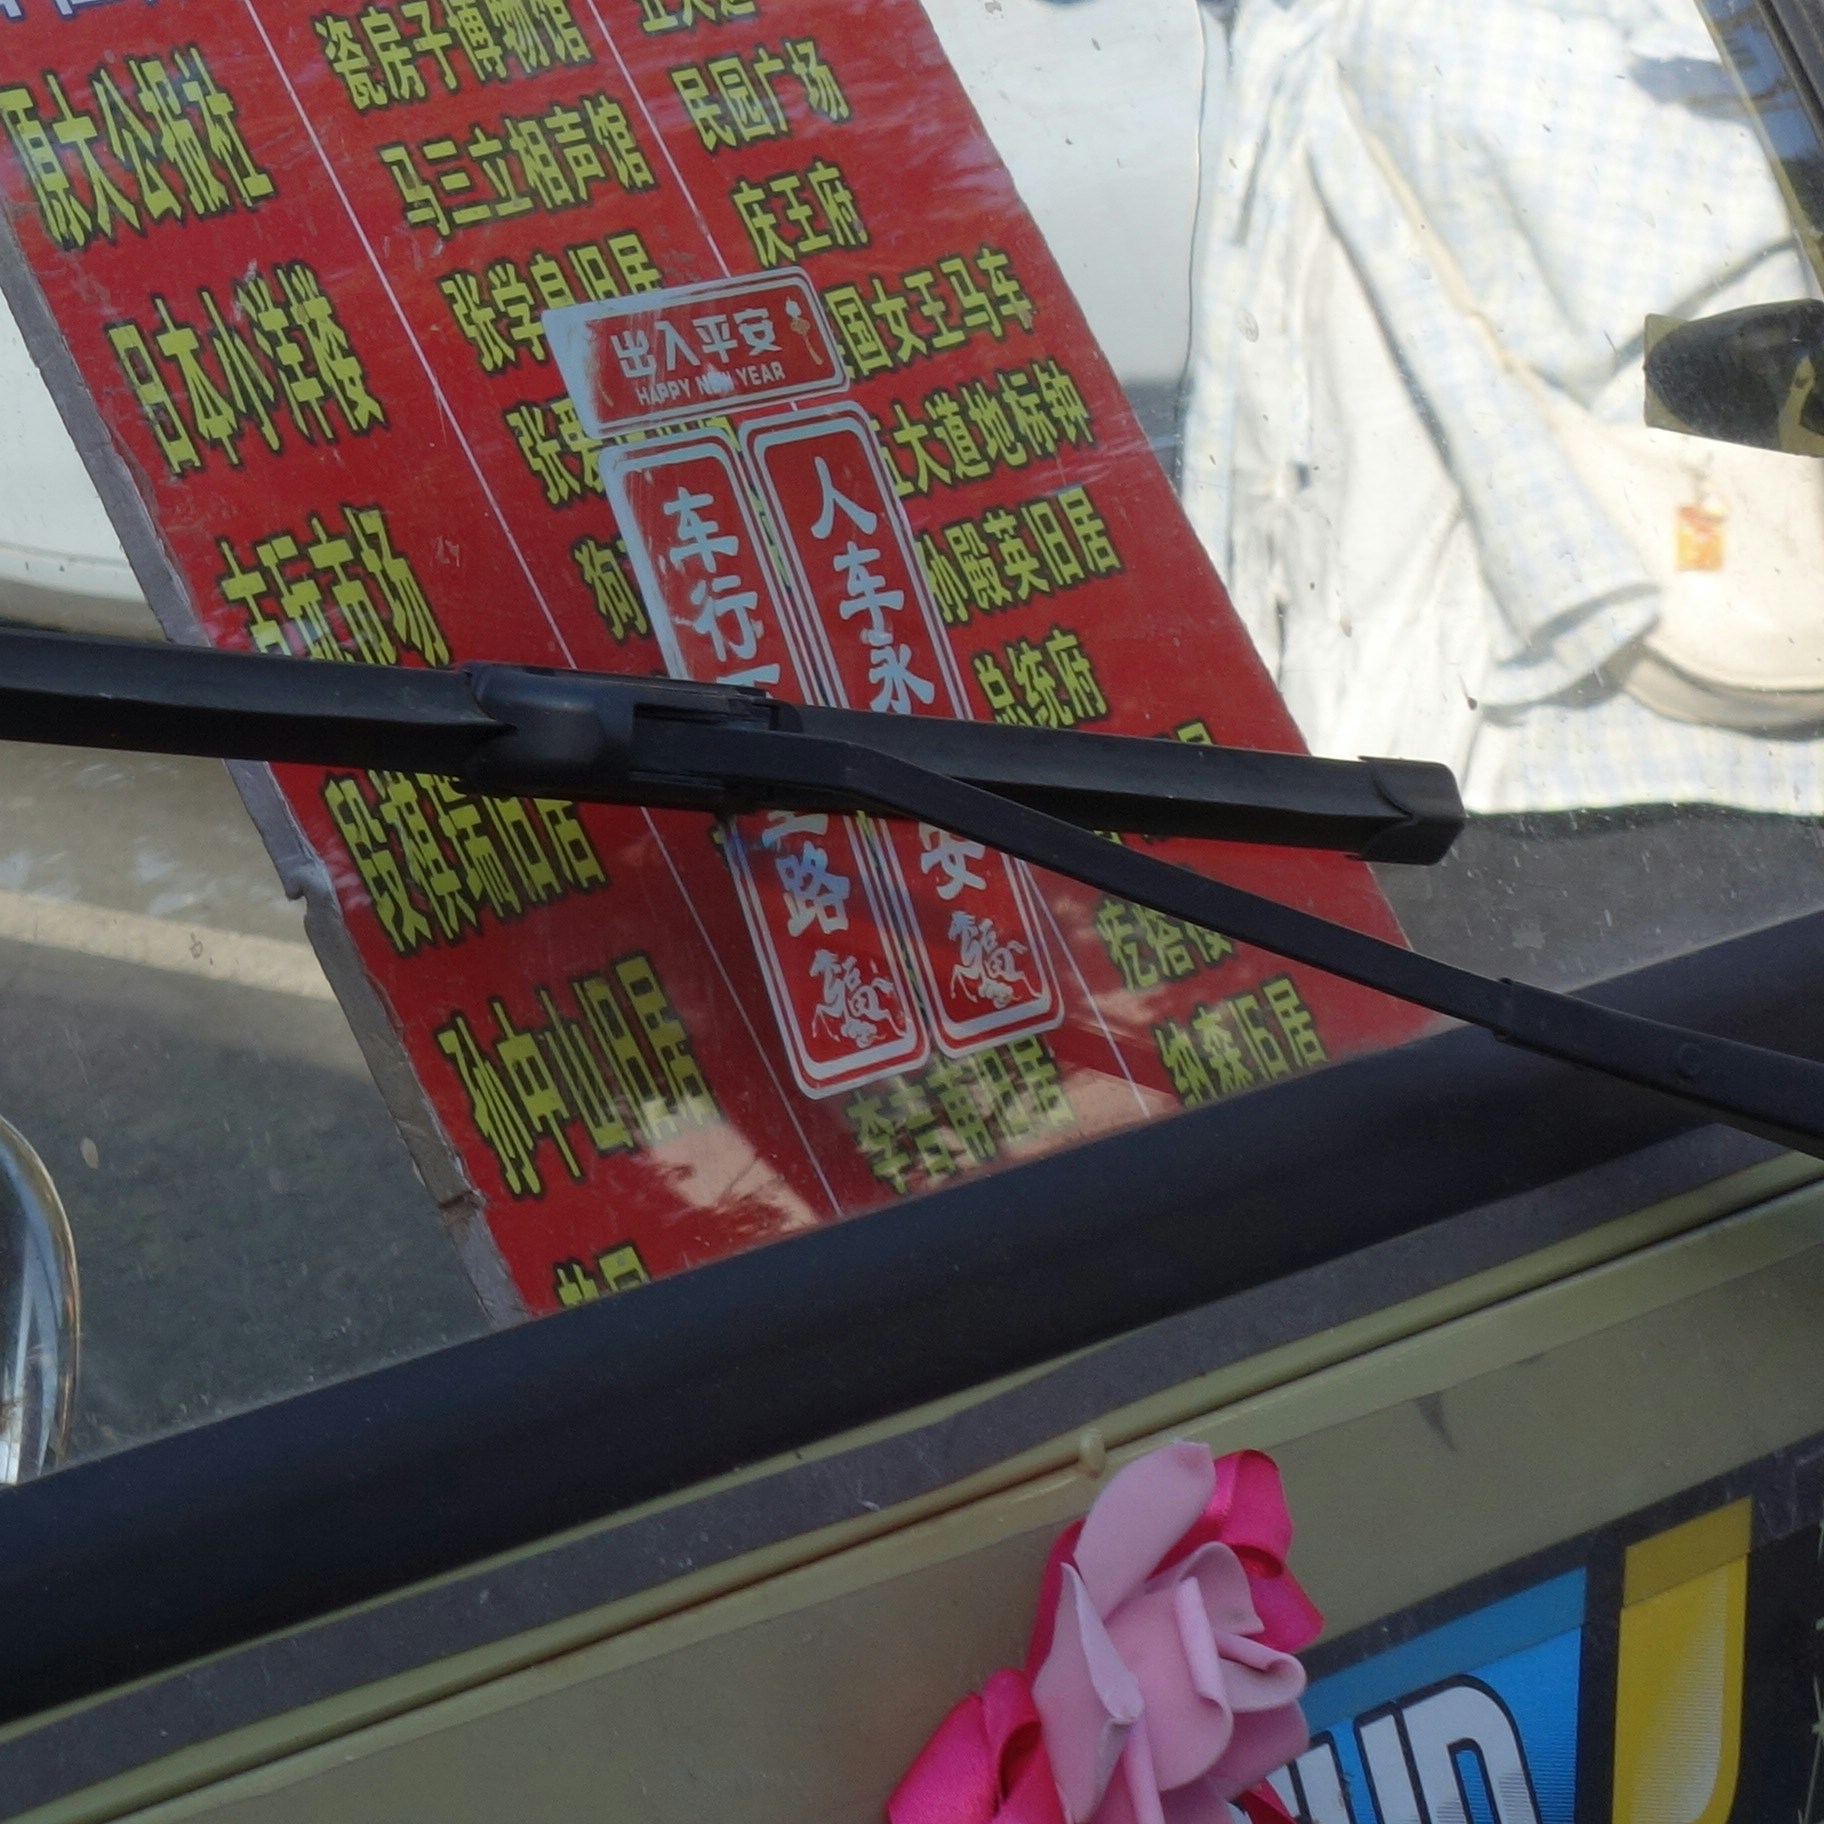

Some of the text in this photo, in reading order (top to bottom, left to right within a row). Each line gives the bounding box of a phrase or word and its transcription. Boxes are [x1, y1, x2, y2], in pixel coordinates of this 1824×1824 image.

[668, 39, 852, 153] 民园广场
[379, 93, 656, 238] 马三立相声馆
[730, 160, 870, 269] 庆王府
[106, 259, 389, 475] 日本小洋楼
[609, 307, 783, 379] 出入平安
[822, 244, 1037, 381] 国女王马车
[635, 378, 692, 406] HAPPY
[735, 361, 786, 388] YEAR
[219, 502, 451, 668] 古玩市场
[914, 486, 1123, 624] 孙殿英旧居
[663, 486, 850, 937] 车行路
[812, 456, 988, 899] 人车永安
[971, 629, 1110, 728] 总统府
[438, 951, 721, 1199] 孙中山旧居
[1154, 975, 1329, 1109] 纳森旧居
